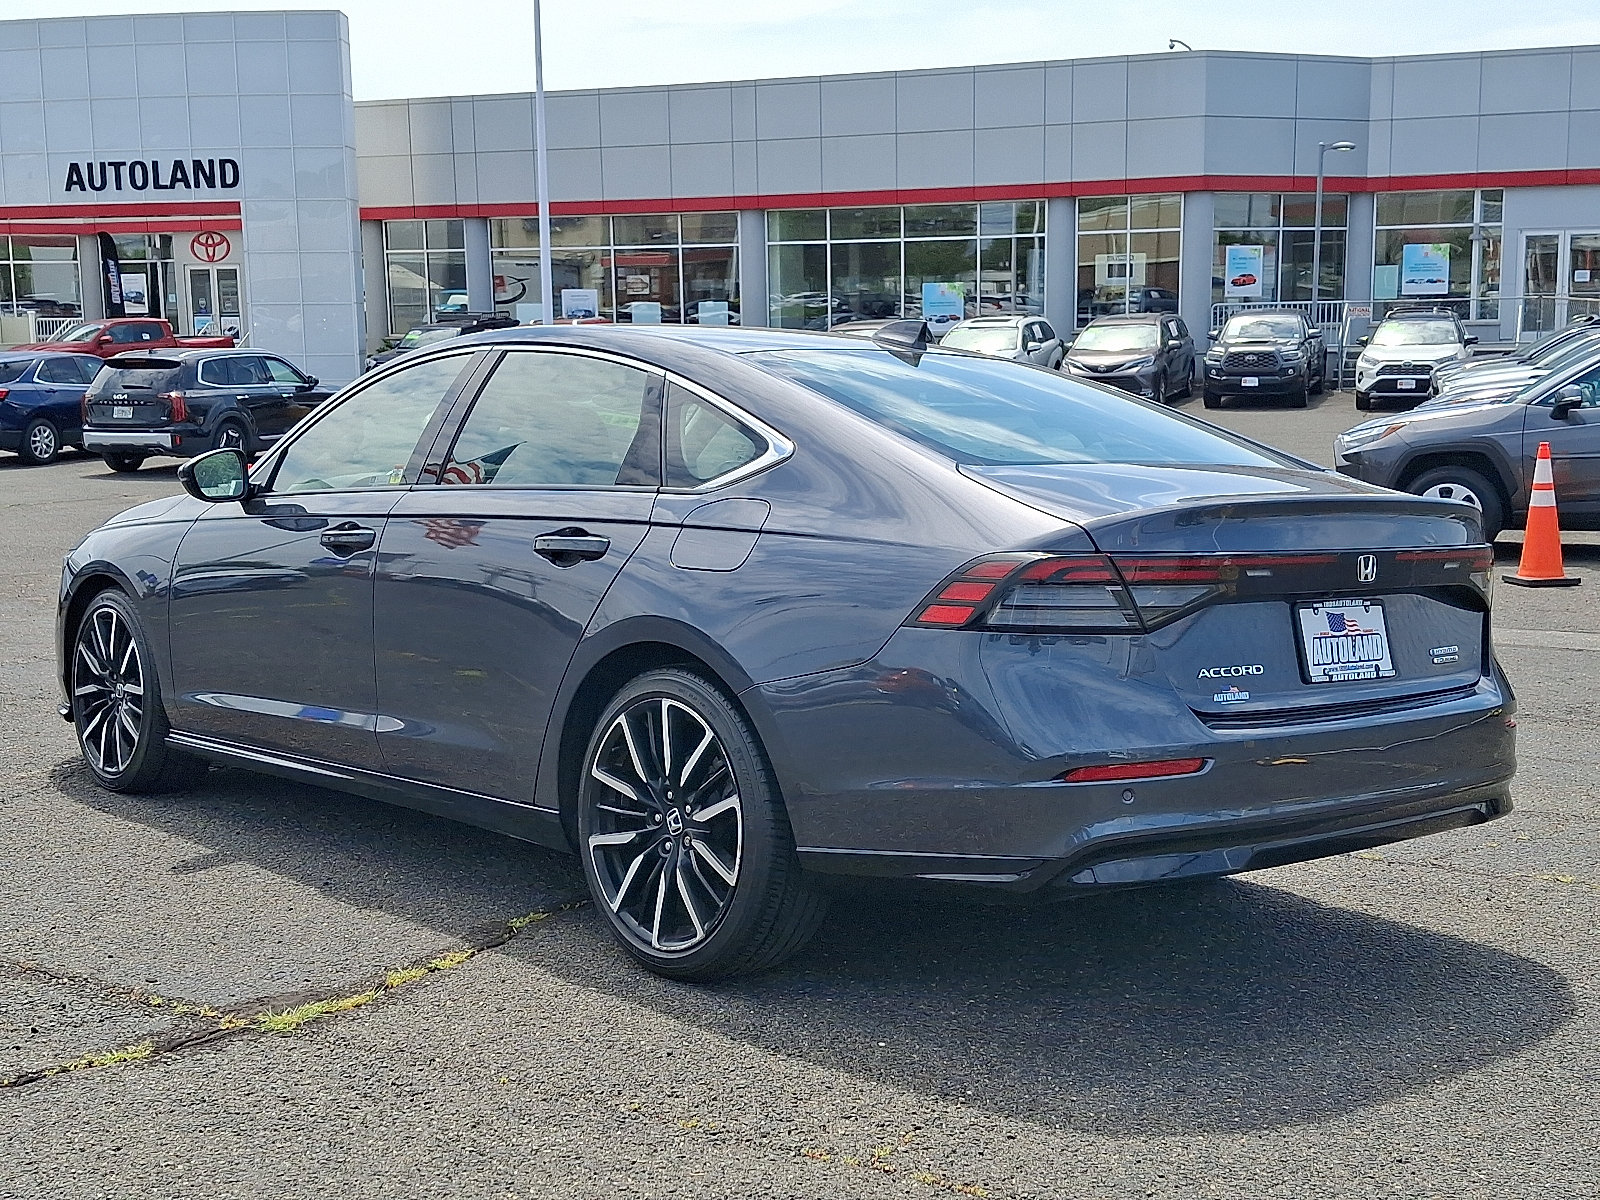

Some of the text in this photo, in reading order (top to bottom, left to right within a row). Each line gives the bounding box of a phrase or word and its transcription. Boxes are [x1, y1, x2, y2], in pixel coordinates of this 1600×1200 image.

[64, 158, 240, 192] AUTOLAND
[1313, 633, 1383, 666] AUTOLAND
[1198, 664, 1264, 679] ACCORD
[1332, 672, 1376, 681] AUTOLAND
[1213, 691, 1249, 702] AUTOLAND
